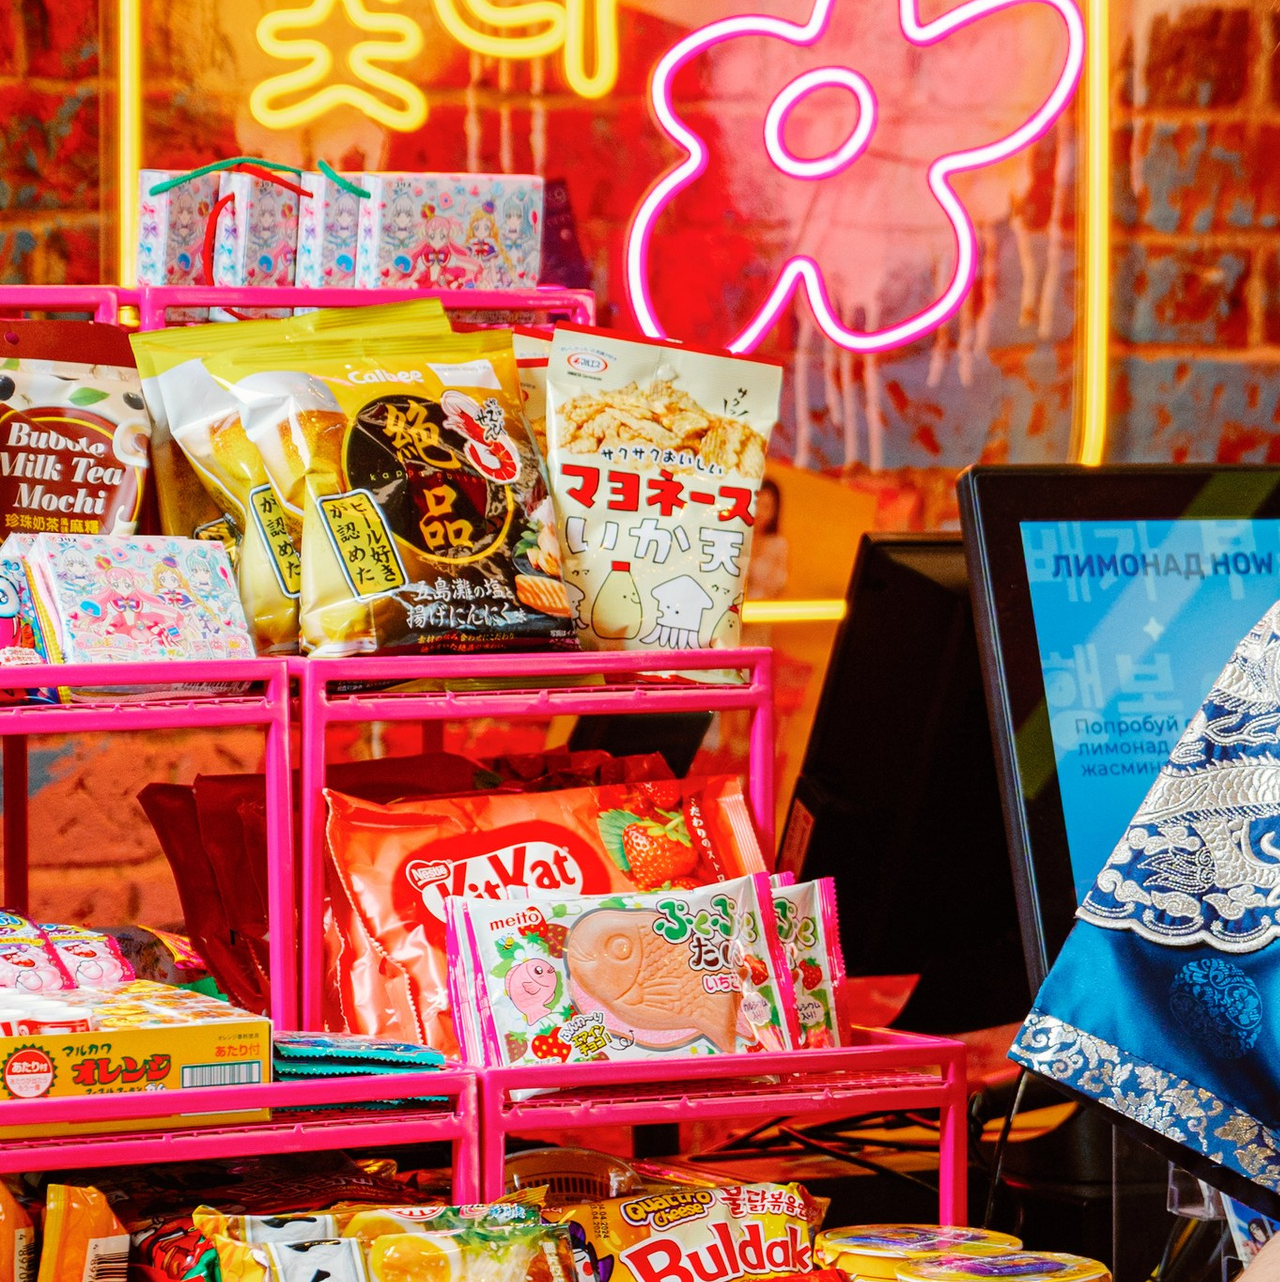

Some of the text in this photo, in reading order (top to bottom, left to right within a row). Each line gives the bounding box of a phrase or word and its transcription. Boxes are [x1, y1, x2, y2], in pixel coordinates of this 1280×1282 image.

[347, 369, 425, 385] Calbee
[0, 451, 123, 486] Milk Tea
[600, 446, 725, 476] サクサクおいしい
[13, 482, 106, 516] Mochi
[565, 515, 745, 578] いか天
[1052, 552, 1206, 581] ЛИМОНАД
[1211, 551, 1275, 576] HOW
[1075, 716, 1180, 739] Попробуй
[1078, 741, 1171, 758] лимонад
[489, 908, 541, 931] meito
[61, 1043, 112, 1057] マルカワ
[214, 1042, 261, 1058] あたり付
[71, 1053, 172, 1087] オレンジ
[626, 1190, 713, 1222] Quattro
[653, 1202, 704, 1226] Cheese
